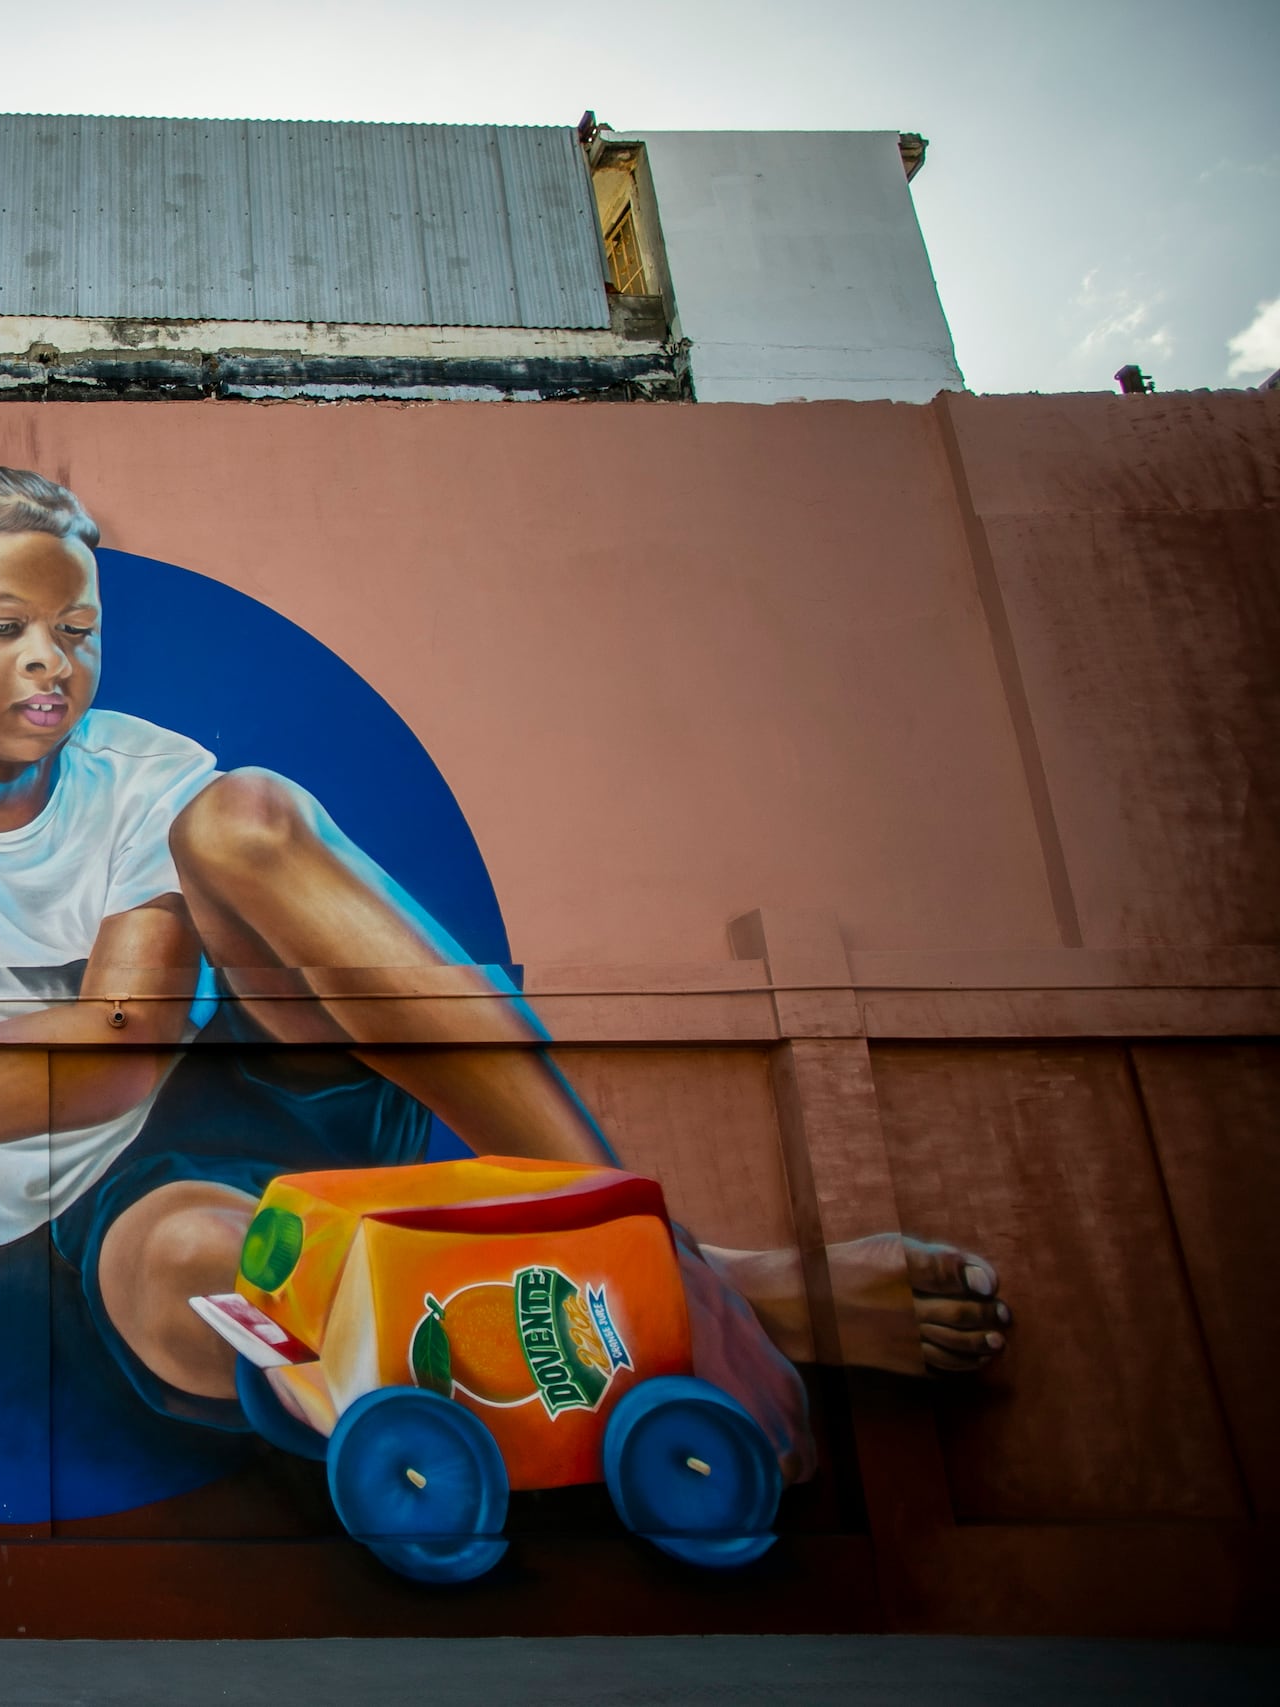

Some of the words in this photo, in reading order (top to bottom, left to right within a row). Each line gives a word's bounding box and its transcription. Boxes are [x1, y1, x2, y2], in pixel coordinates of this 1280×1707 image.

[593, 1302, 609, 1325] JUICE
[520, 1268, 588, 1409] DOVENTE
[602, 1326, 623, 1359] ORANGE
